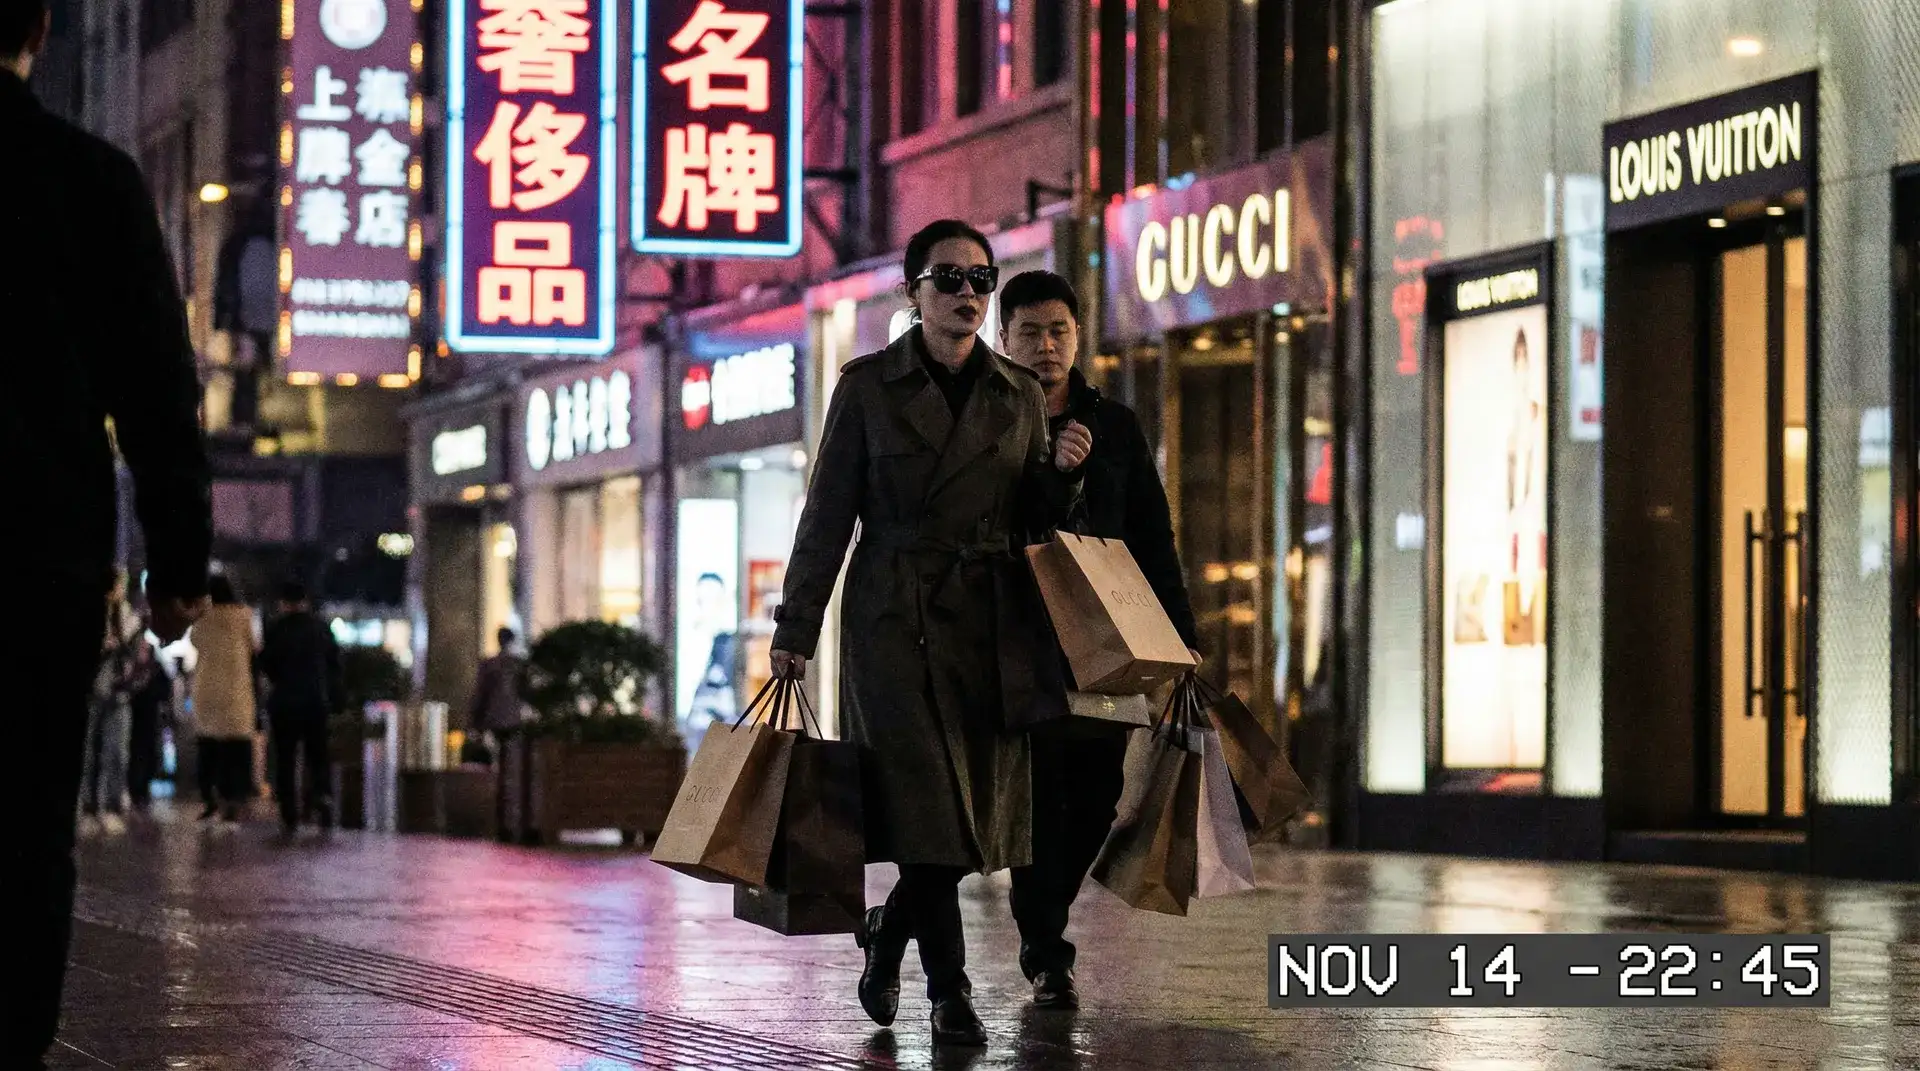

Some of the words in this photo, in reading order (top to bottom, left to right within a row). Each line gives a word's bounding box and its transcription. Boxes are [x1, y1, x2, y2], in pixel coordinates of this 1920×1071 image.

[473, 0, 592, 326] 奢侈品
[656, 0, 779, 232] 名牌
[1609, 130, 1682, 203] LOUIS
[1686, 100, 1801, 186] VUITTON
[1136, 188, 1290, 302] GUCCI
[1110, 589, 1153, 608] GUCCI
